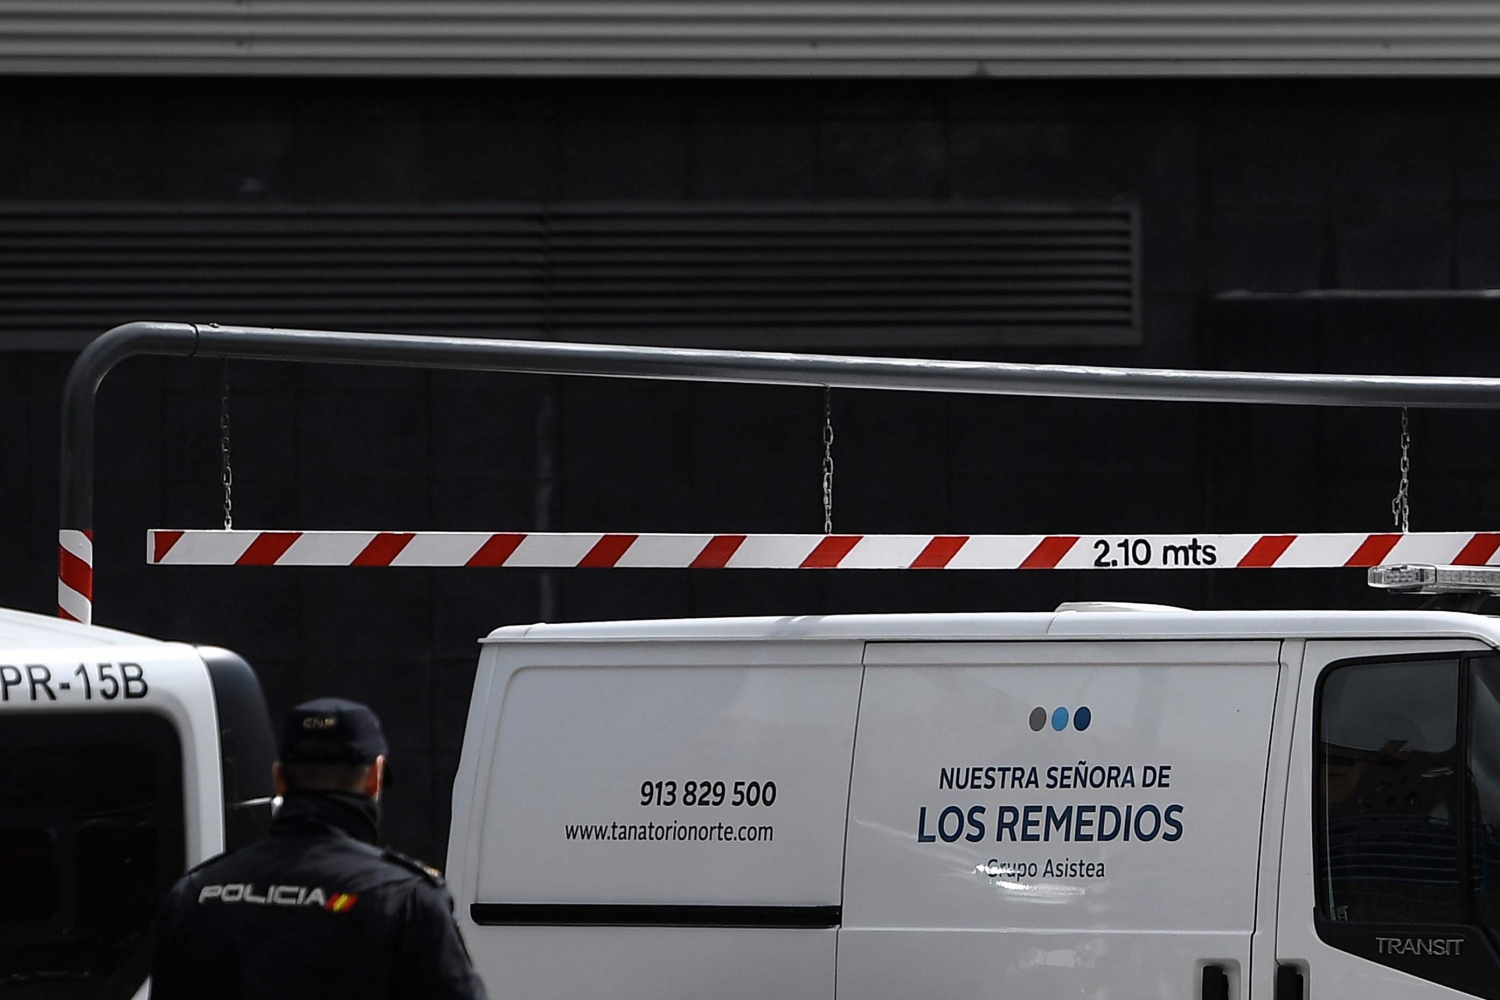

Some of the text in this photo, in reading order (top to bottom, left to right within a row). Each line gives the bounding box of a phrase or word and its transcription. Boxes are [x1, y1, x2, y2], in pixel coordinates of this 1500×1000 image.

[1093, 537, 1217, 567] 2.10 mts
[0, 661, 149, 702] PR-15B
[939, 760, 1172, 790] NUESTRA SEÑORA DE
[639, 780, 777, 807] 913 829 500
[565, 820, 774, 842] www.tanatorionorte.com
[917, 804, 1185, 843] LOS REMEDIOS
[986, 857, 1105, 881] Grupo Asistea
[198, 883, 326, 906] POLICIA
[1375, 936, 1465, 956] TRANSIT
